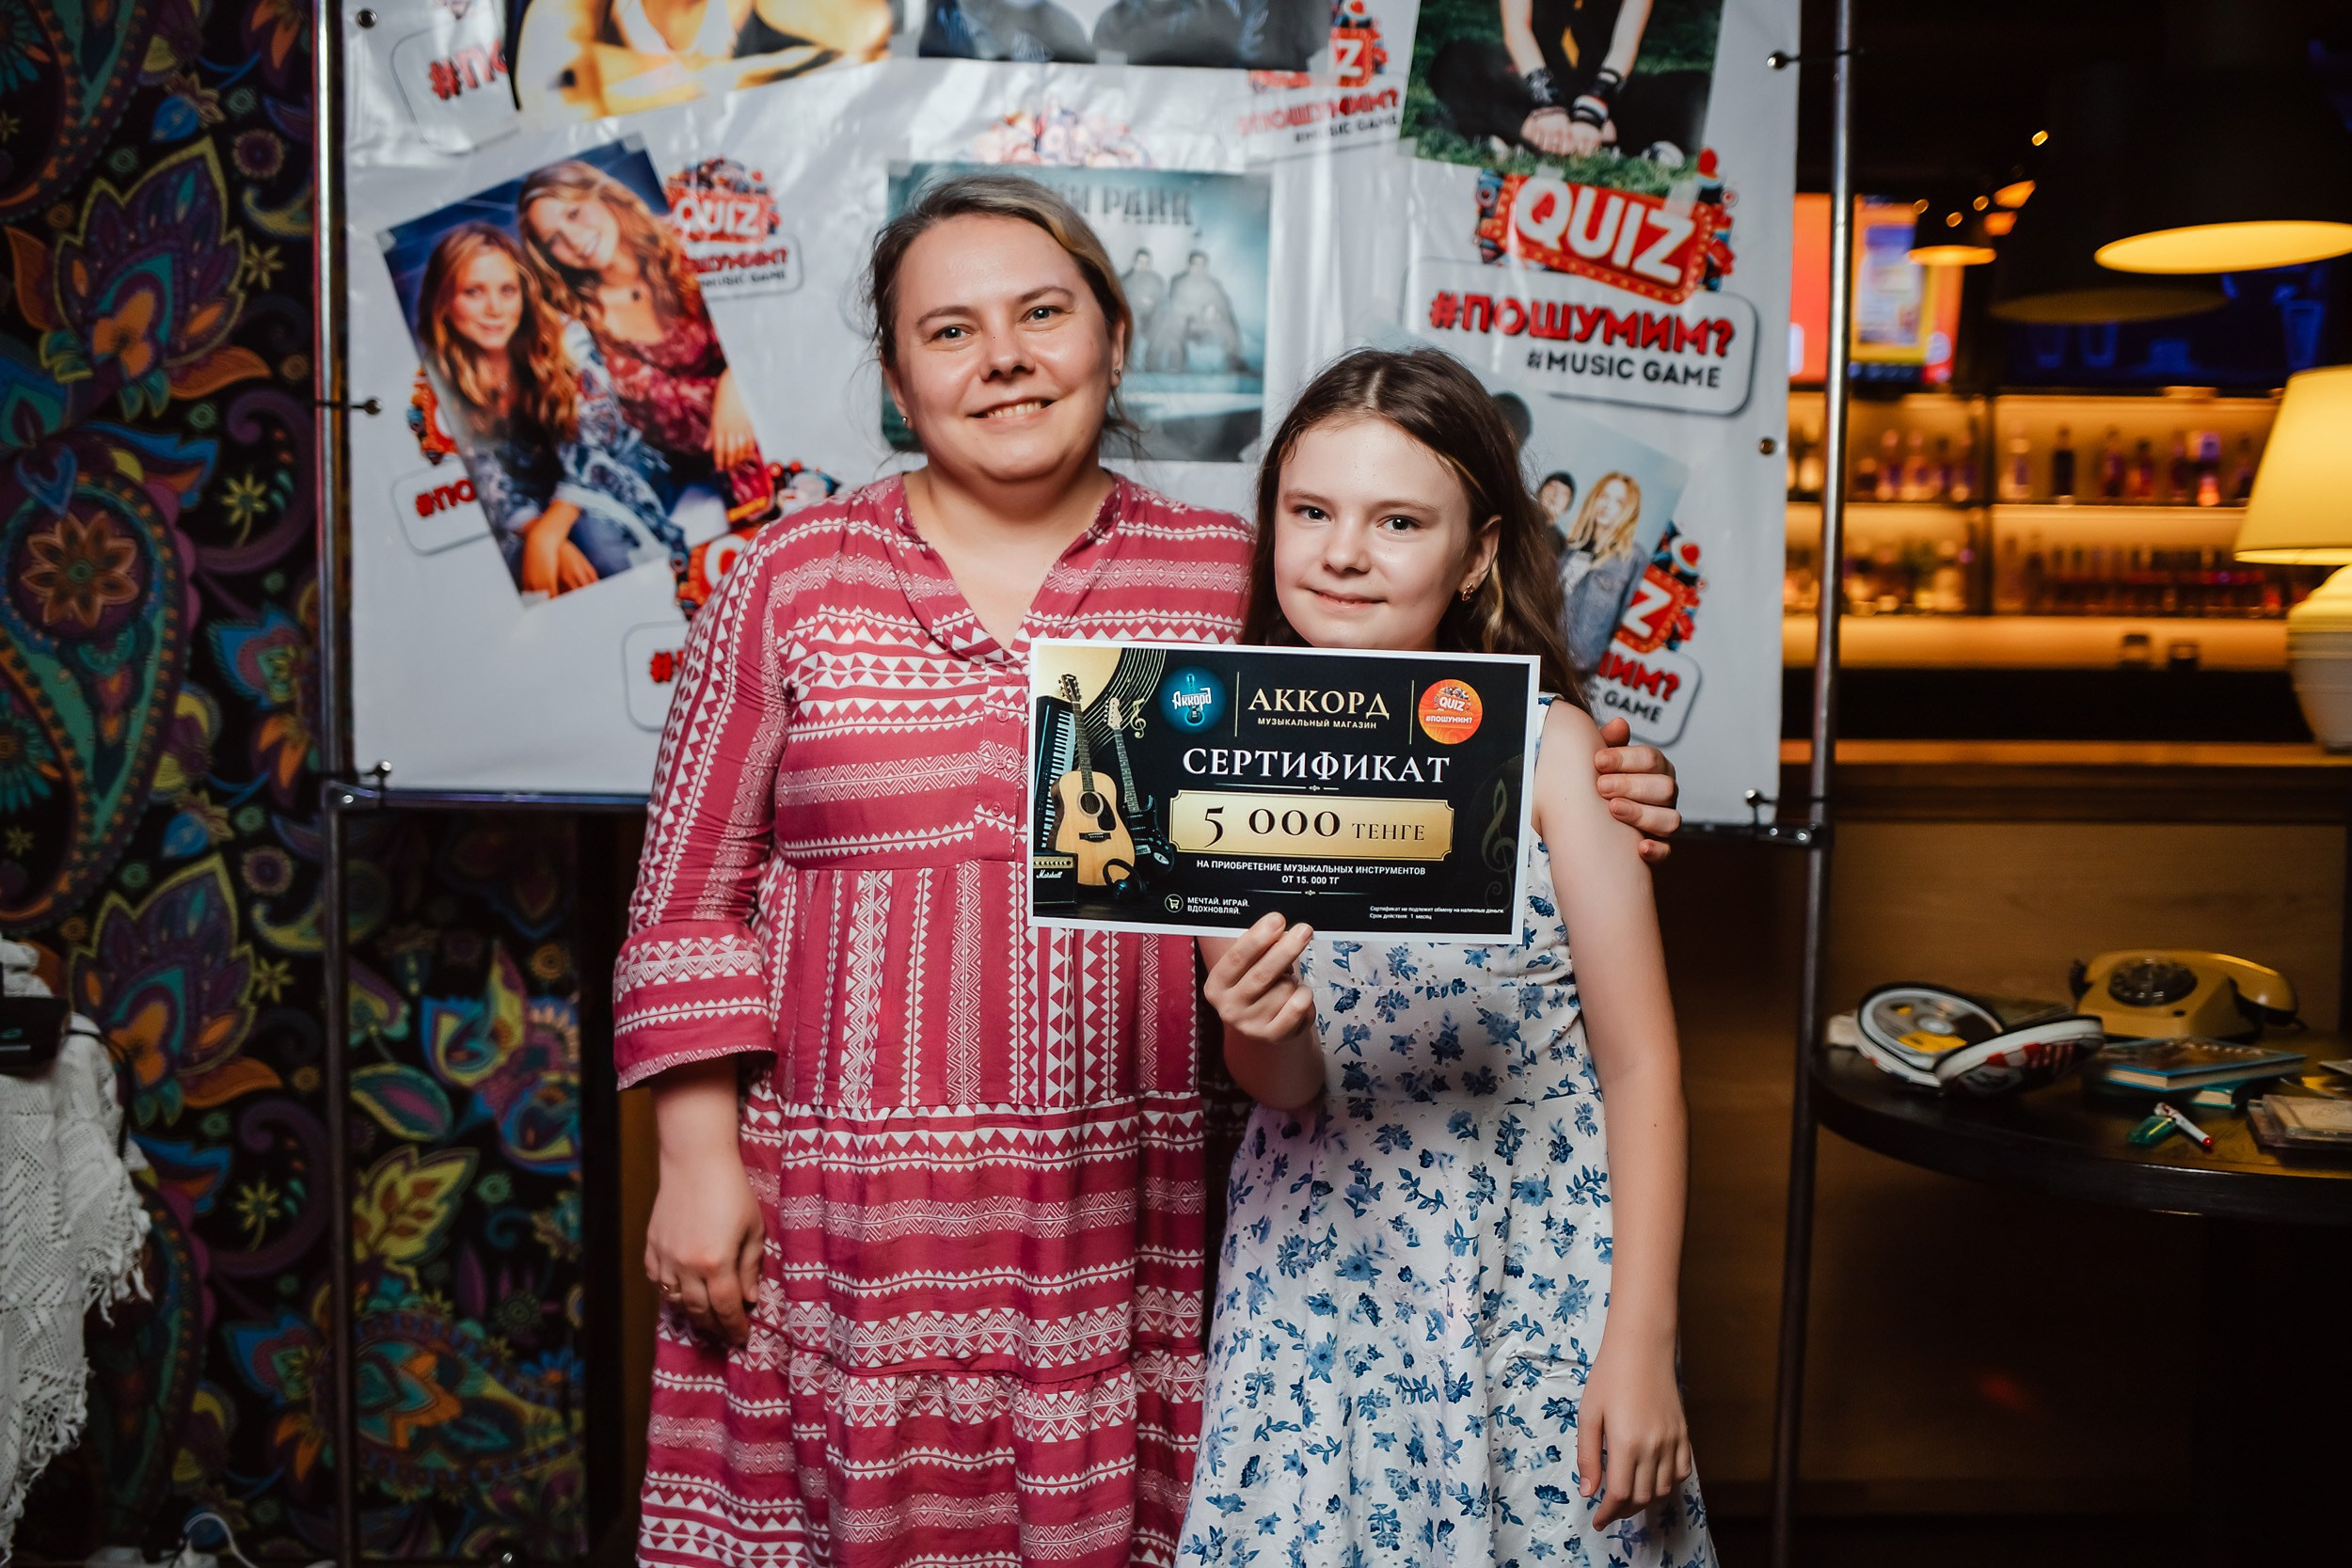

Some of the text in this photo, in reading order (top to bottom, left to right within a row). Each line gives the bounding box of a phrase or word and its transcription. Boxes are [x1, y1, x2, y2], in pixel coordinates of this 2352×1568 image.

[675, 197, 760, 235] QUIZ
[1516, 176, 1694, 284] QUIZ
[1429, 290, 1736, 357] #ПОШУМИМ?
[1527, 348, 1722, 388] #MUSIC GAME
[1248, 688, 1391, 721] АККОРД
[1438, 696, 1466, 712] QUIZ
[1603, 689, 1664, 724] GAME
[1257, 717, 1377, 729] МУЗЫКАЛЬНЫЙ МАГАЗИН
[1183, 747, 1451, 784] СЕРТИФИКАТ
[1204, 805, 1426, 848] 5 000 ТЕНГЕ
[1197, 860, 1426, 876] НА ПРИОБРЕТЕНИЕ МУЗЫКАЛЬНЫХ ИНСТРУМЕНТОВ
[1281, 875, 1294, 884] ОТ
[1311, 876, 1327, 885] 000
[1328, 877, 1341, 885] ТГ
[1187, 896, 1250, 908] МЕЧТАЙ. ИГРАЙ.
[1187, 905, 1241, 915] ВДОХНОВЛЯЙ.
